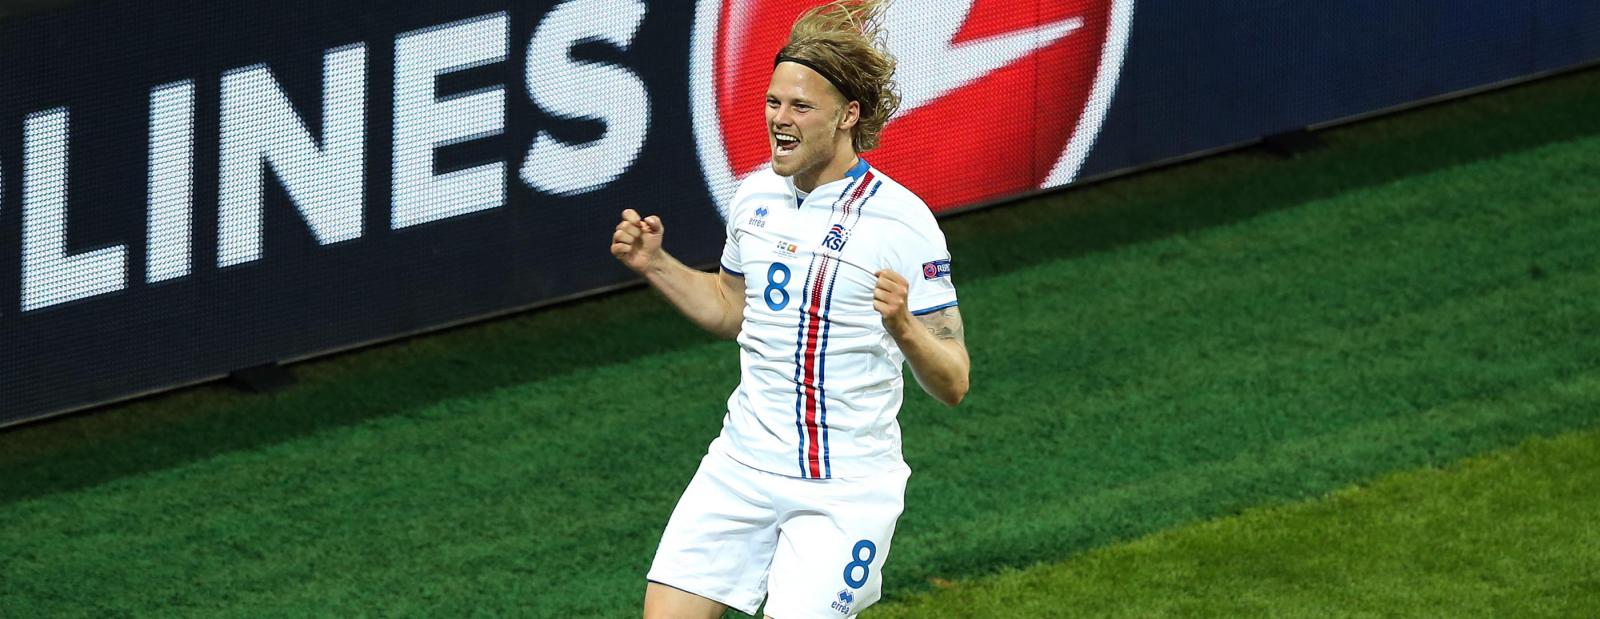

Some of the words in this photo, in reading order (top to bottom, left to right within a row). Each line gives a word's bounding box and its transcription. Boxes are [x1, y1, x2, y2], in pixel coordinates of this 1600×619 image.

[0, 0, 652, 313] LINES
[764, 262, 791, 311] 8
[843, 539, 876, 589] 8
